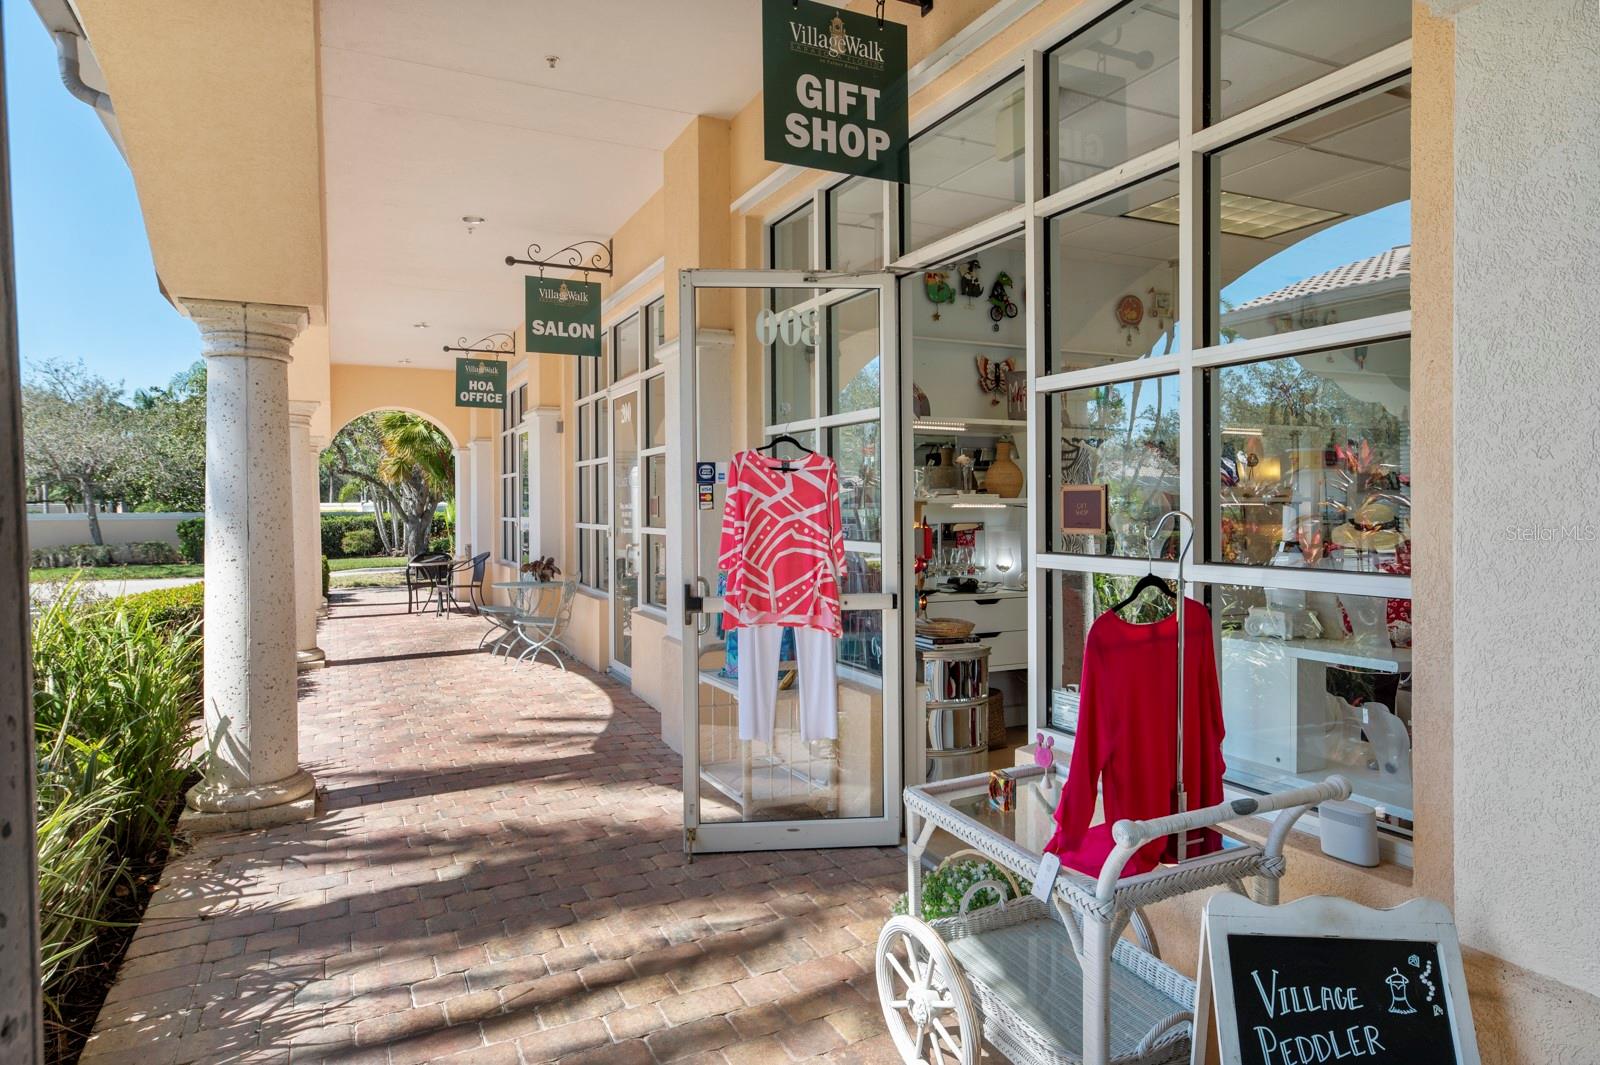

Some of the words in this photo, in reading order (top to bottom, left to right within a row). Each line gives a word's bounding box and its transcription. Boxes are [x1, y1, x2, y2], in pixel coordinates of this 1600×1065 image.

[796, 73, 881, 121] GIFT
[785, 112, 891, 161] SHOP
[531, 319, 595, 339] SALON
[459, 391, 503, 404] OFFICE
[468, 380, 495, 392] HOA
[1250, 968, 1364, 1020] VILLAGE
[1252, 1024, 1386, 1065] PEDDLER
